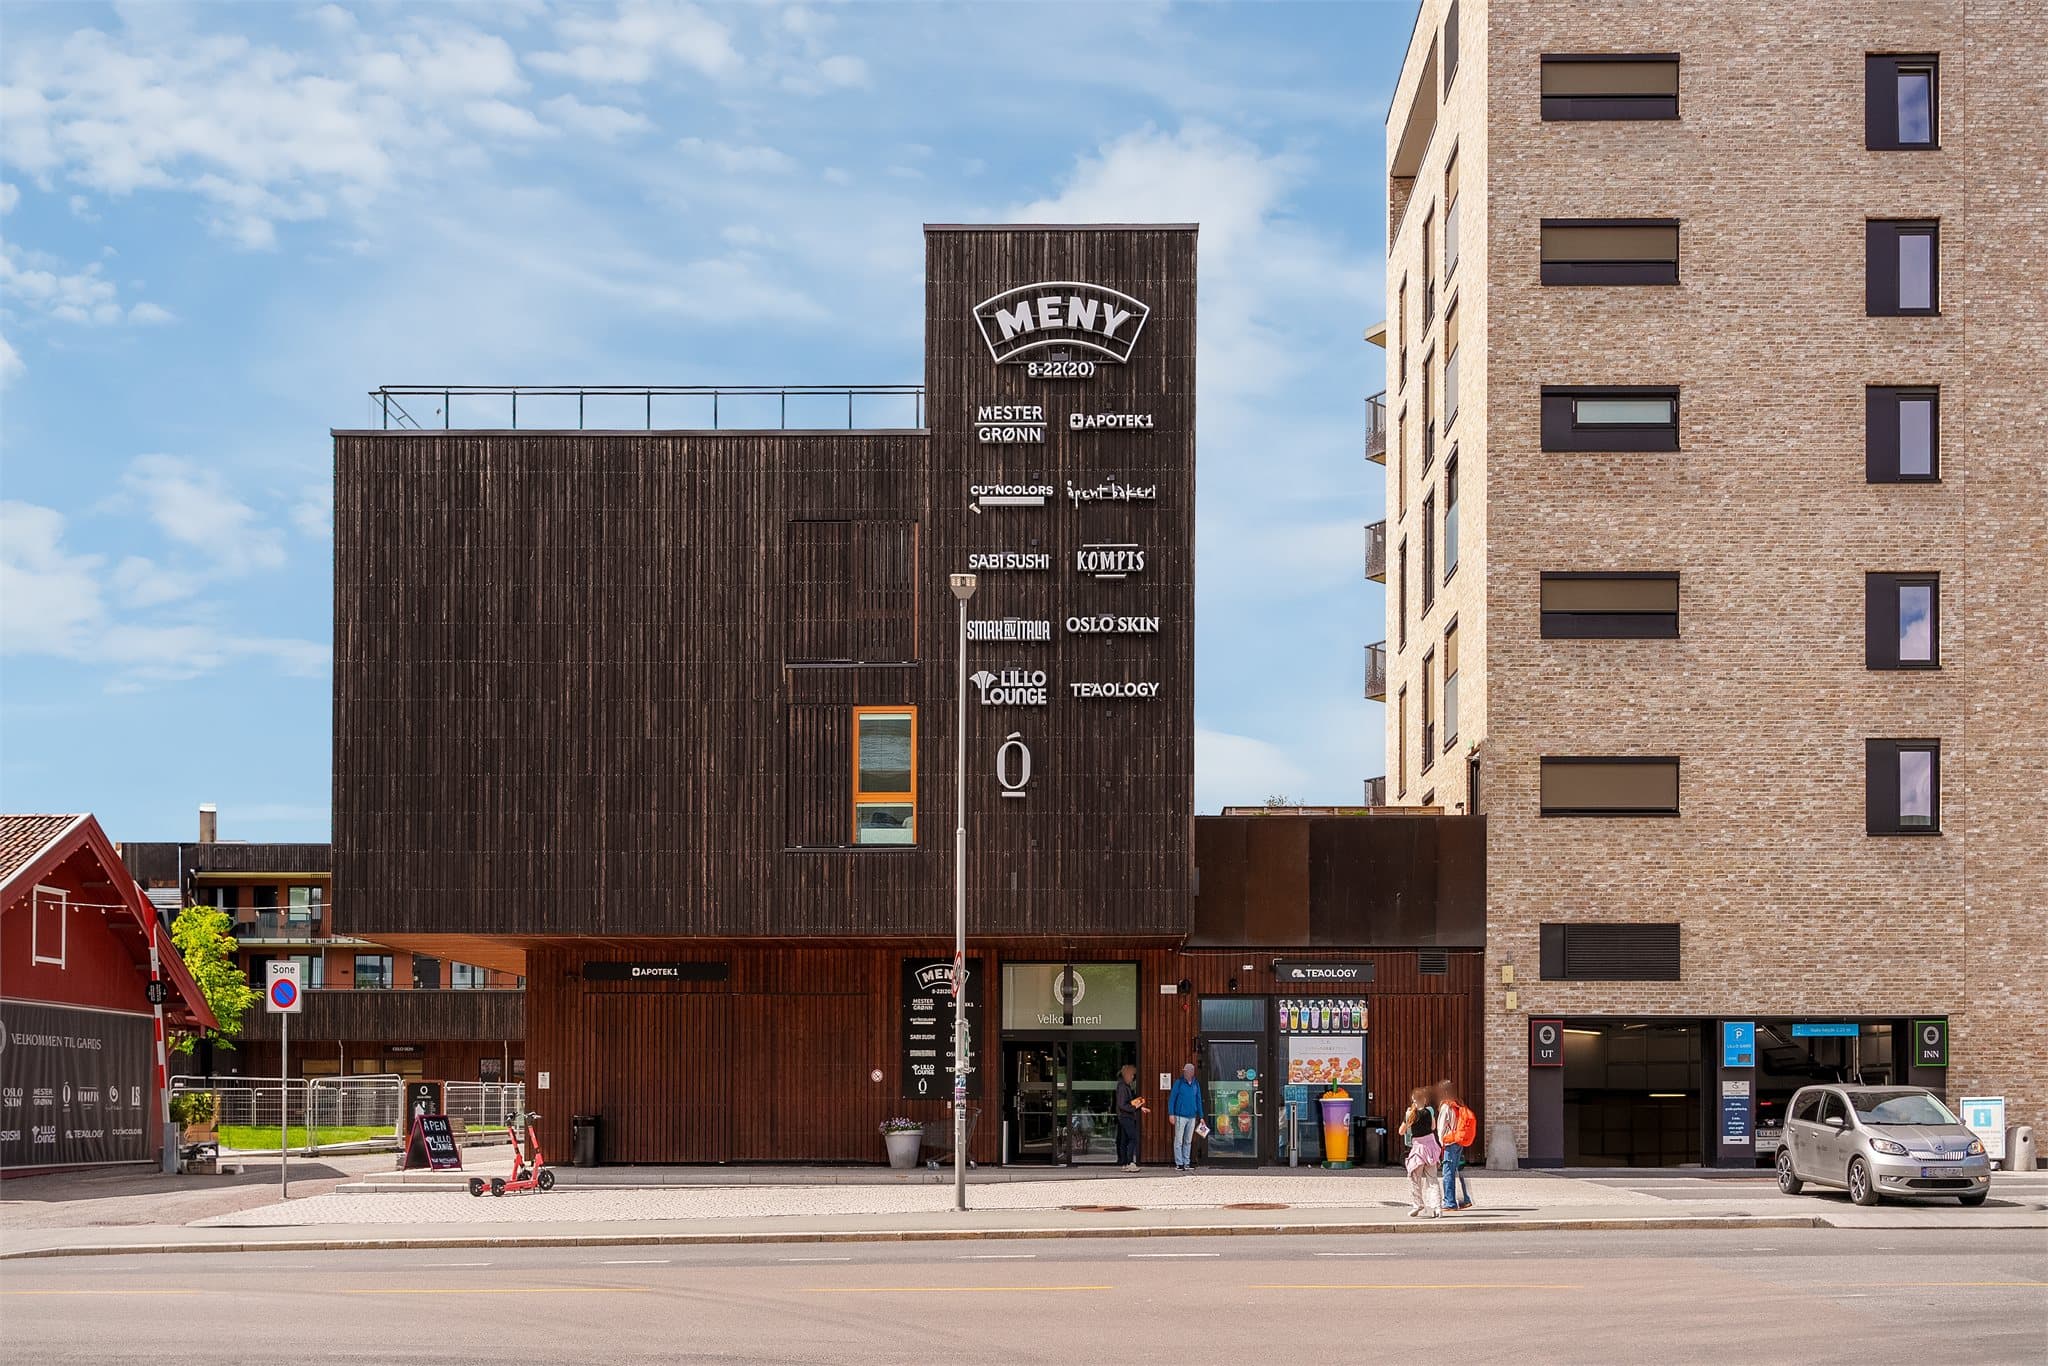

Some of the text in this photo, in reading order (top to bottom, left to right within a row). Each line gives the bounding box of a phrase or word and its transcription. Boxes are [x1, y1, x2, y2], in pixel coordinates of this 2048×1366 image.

[995, 296, 1131, 342] MENY
[1027, 361, 1095, 378] 8-22(20)
[977, 406, 1043, 421] MESTER
[978, 427, 1042, 442] GRØNN
[968, 553, 1049, 569] SABI SUSHI
[1077, 550, 1145, 571] KOMPIS
[967, 620, 1004, 640] SMAK
[1017, 620, 1051, 640] ITALIA
[1066, 616, 1160, 632] OSLO SKIN
[1001, 671, 1047, 687] LILLO
[981, 687, 1047, 705] LOUNGE
[1070, 683, 1159, 698] TEAOLOGY
[272, 964, 295, 974] Sone
[921, 968, 953, 983] MEN
[1305, 969, 1358, 978] TEAOLOGY
[11, 1033, 62, 1047] VELKOMMEN
[64, 1036, 76, 1048] TIL
[1541, 1049, 1554, 1058] UT
[1923, 1050, 1940, 1058] INN
[3, 1087, 24, 1097] OSLO
[0, 1130, 21, 1141] SUSHI
